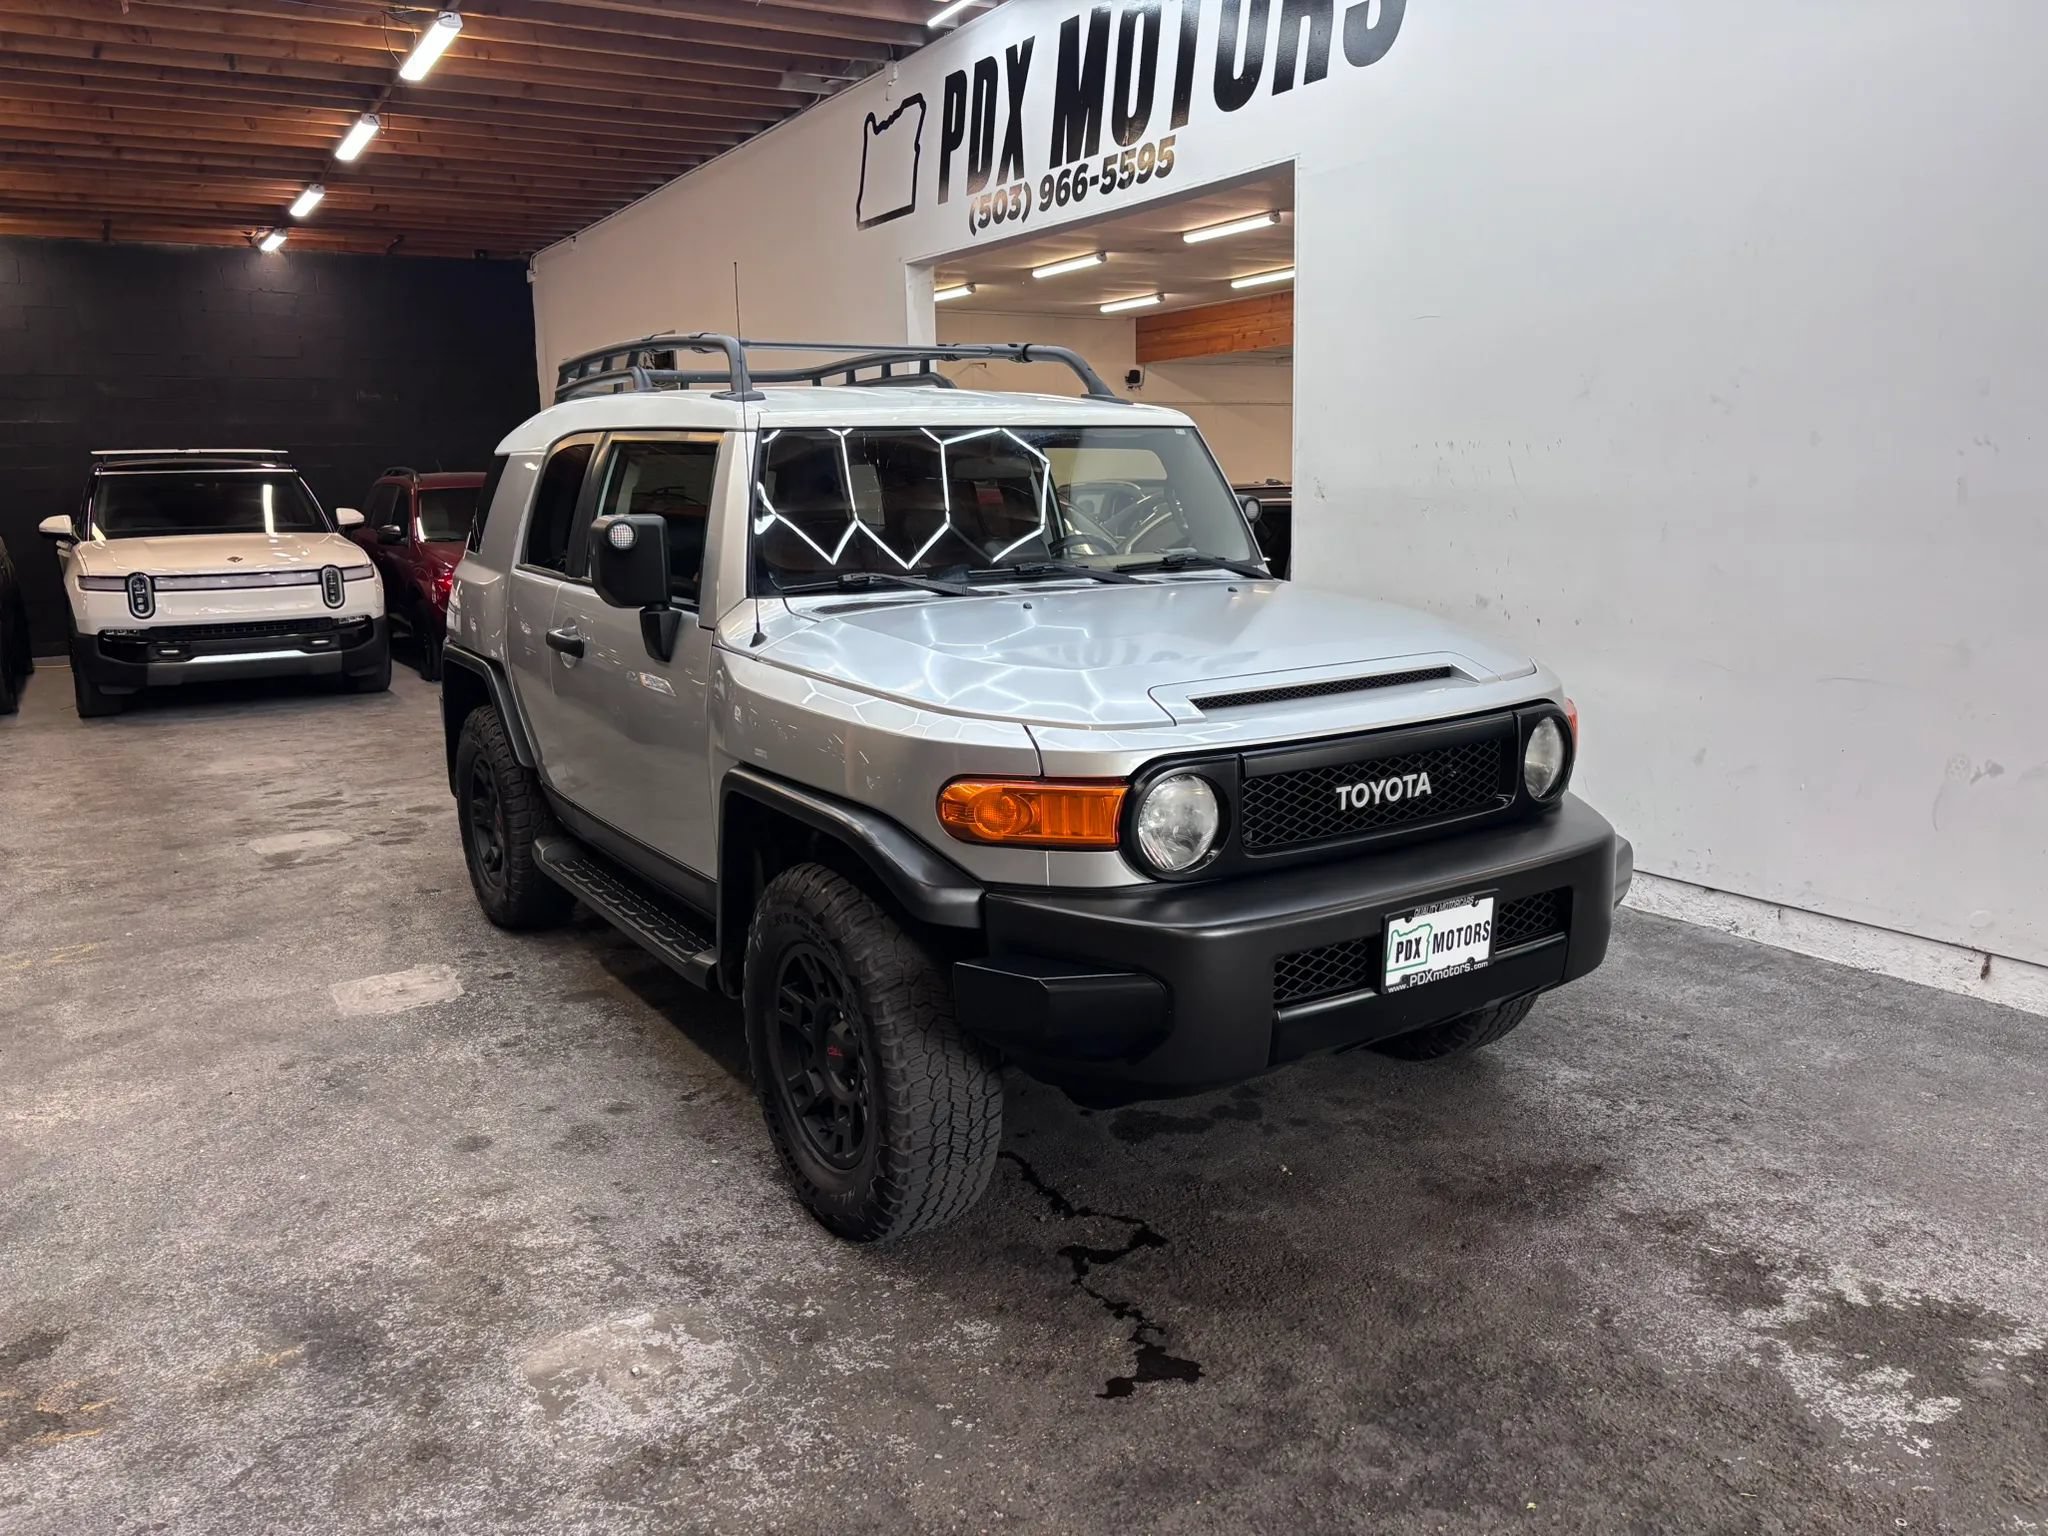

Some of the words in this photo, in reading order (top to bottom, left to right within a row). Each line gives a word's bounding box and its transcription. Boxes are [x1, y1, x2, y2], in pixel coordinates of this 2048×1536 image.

[937, 35, 1036, 205] PDX
[968, 181, 1032, 236] (503)
[1038, 134, 1176, 211] 966-5595
[1335, 771, 1432, 811] TOYOTA
[1395, 936, 1422, 964] PDX
[1432, 920, 1491, 955] MOTORS
[1387, 961, 1488, 993] www.PDXmotors.com
